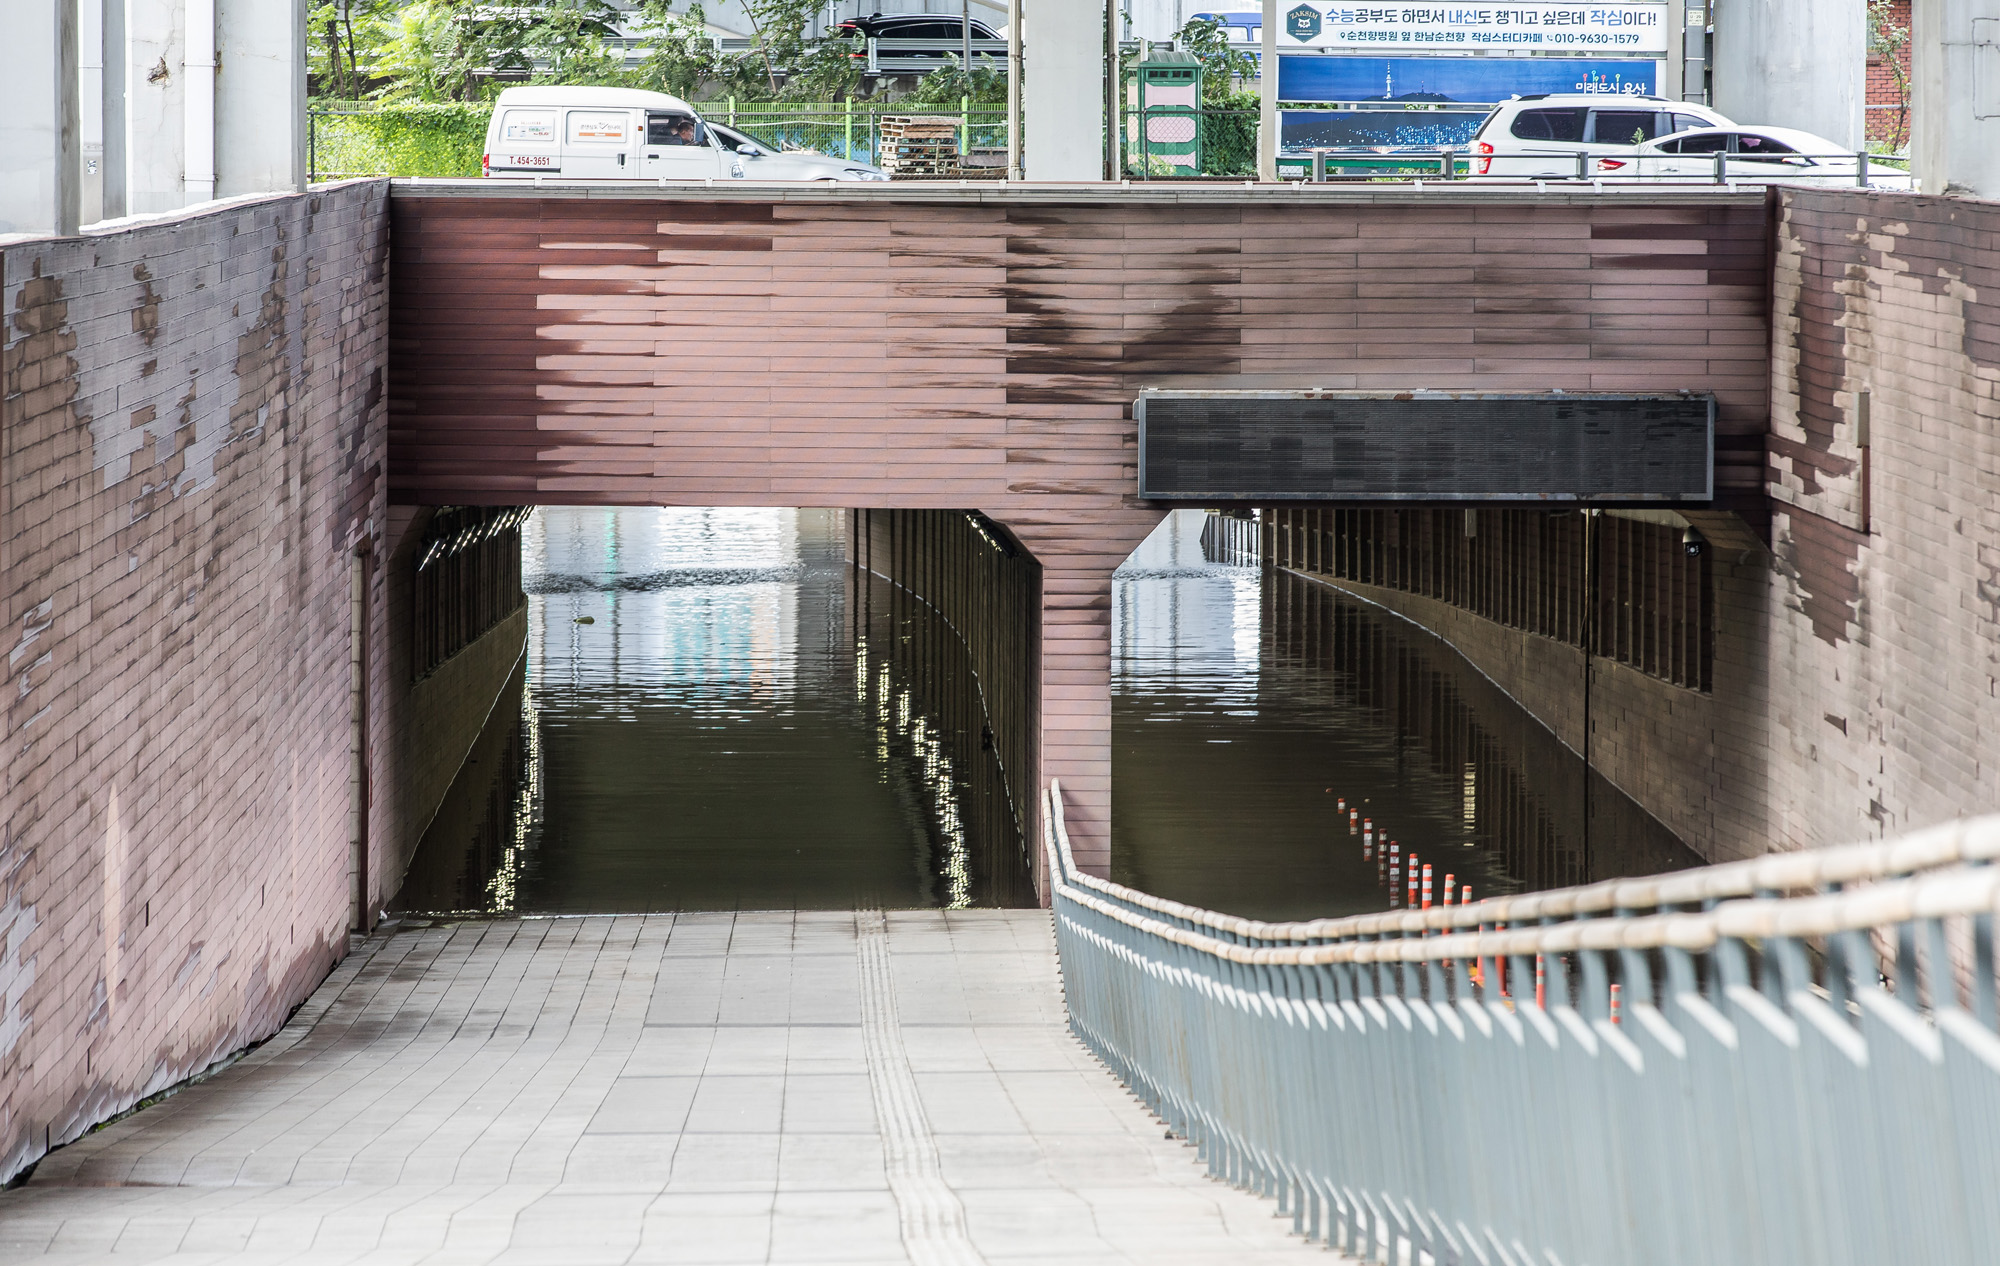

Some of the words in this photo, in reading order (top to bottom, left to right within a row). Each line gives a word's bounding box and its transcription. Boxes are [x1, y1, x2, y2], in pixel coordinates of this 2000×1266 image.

[1325, 9, 1398, 24] 수능공부도
[1402, 9, 1445, 24] 하면서
[1449, 10, 1491, 24] 내신도
[1496, 10, 1538, 25] 챙기고
[1543, 11, 1585, 25] 싶은데
[1590, 10, 1657, 26] 작심이다!
[1347, 31, 1398, 42] 순천향병원
[1401, 32, 1411, 42] 옆
[1414, 32, 1465, 42] 한남순천향
[1471, 32, 1543, 42] 작심스터디카페
[1555, 34, 1639, 43] 010-9630-1579
[1576, 82, 1619, 94] 미래도시
[509, 155, 550, 165] T.454-3651
